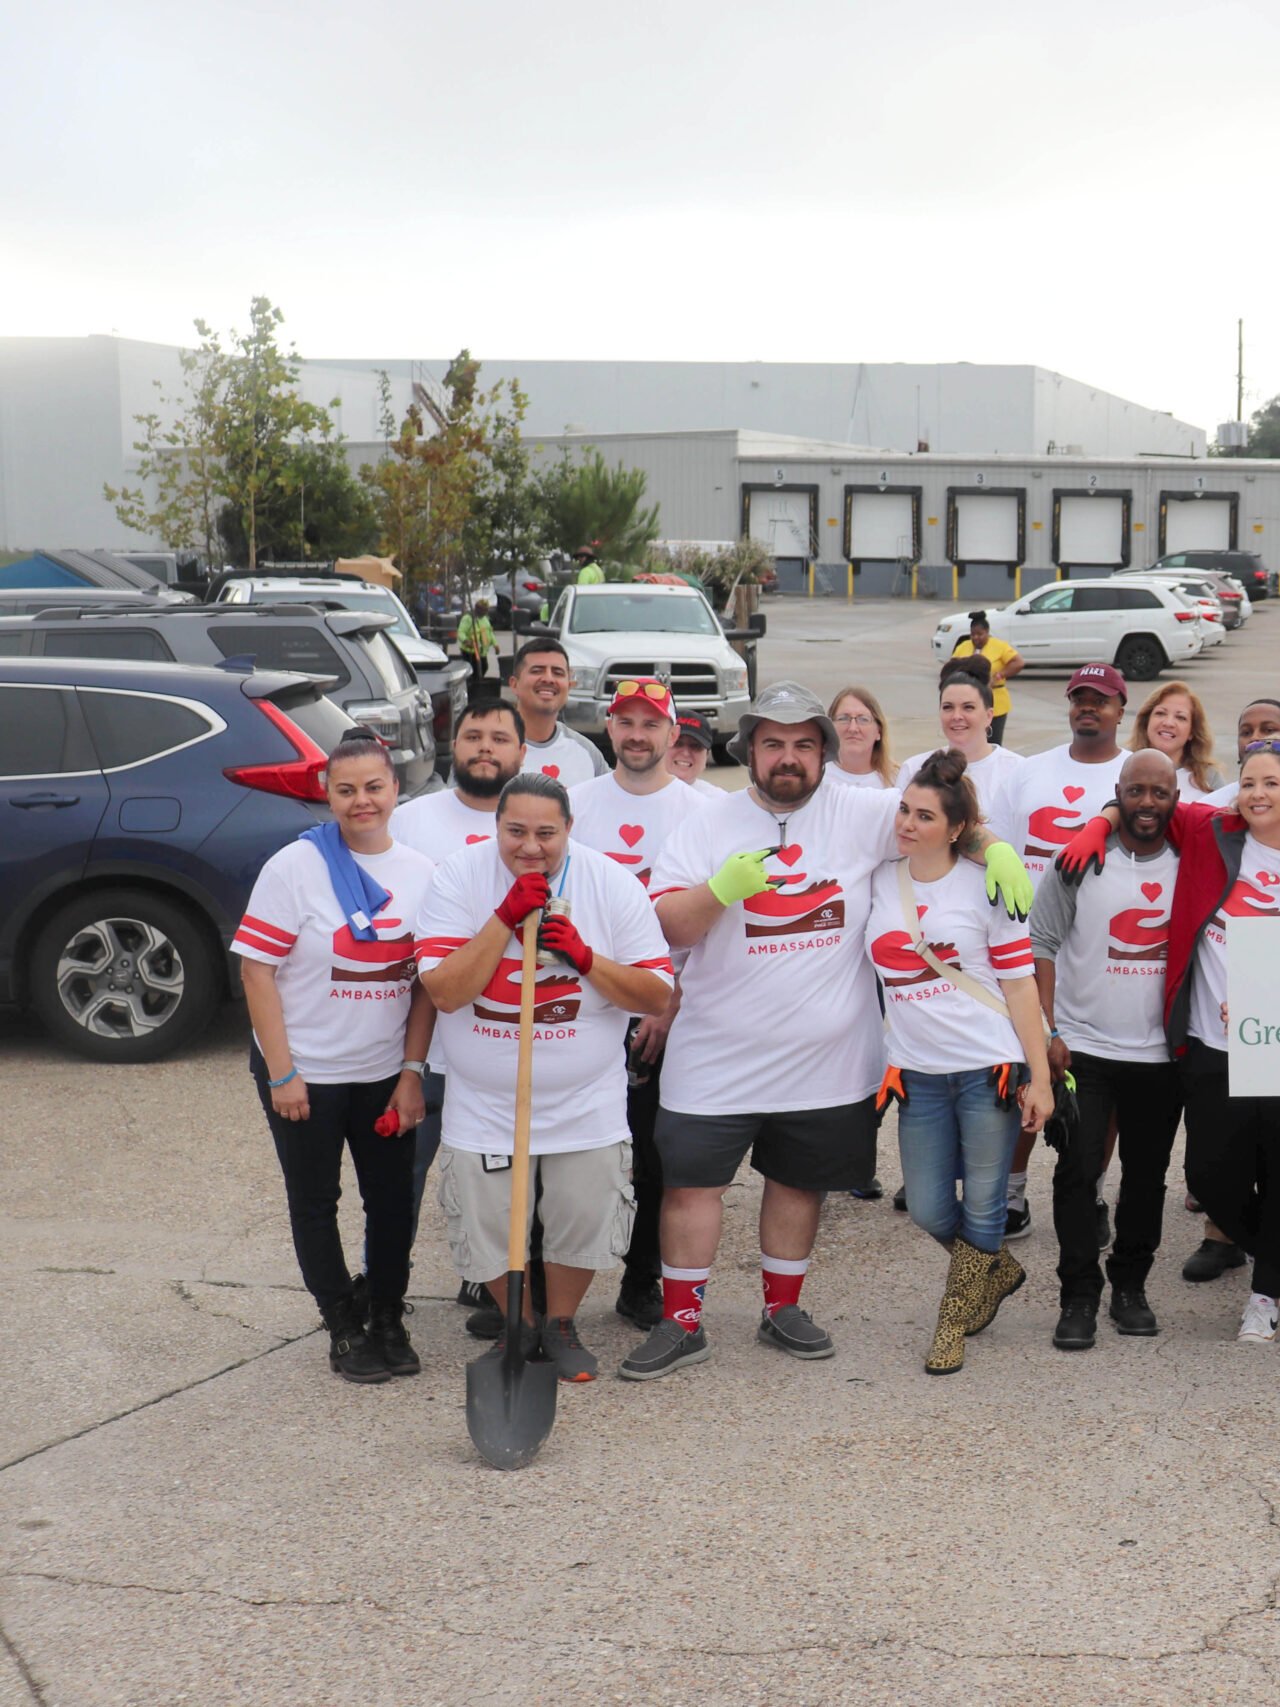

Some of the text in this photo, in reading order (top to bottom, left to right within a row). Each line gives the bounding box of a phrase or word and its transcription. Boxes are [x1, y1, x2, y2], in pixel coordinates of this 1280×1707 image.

[777, 470, 784, 480] 5
[880, 472, 887, 481] 4
[977, 474, 984, 483] 3
[1090, 476, 1097, 486] 2
[748, 935, 841, 955] AMBASSADOR
[473, 1024, 576, 1041] AMBASADOR
